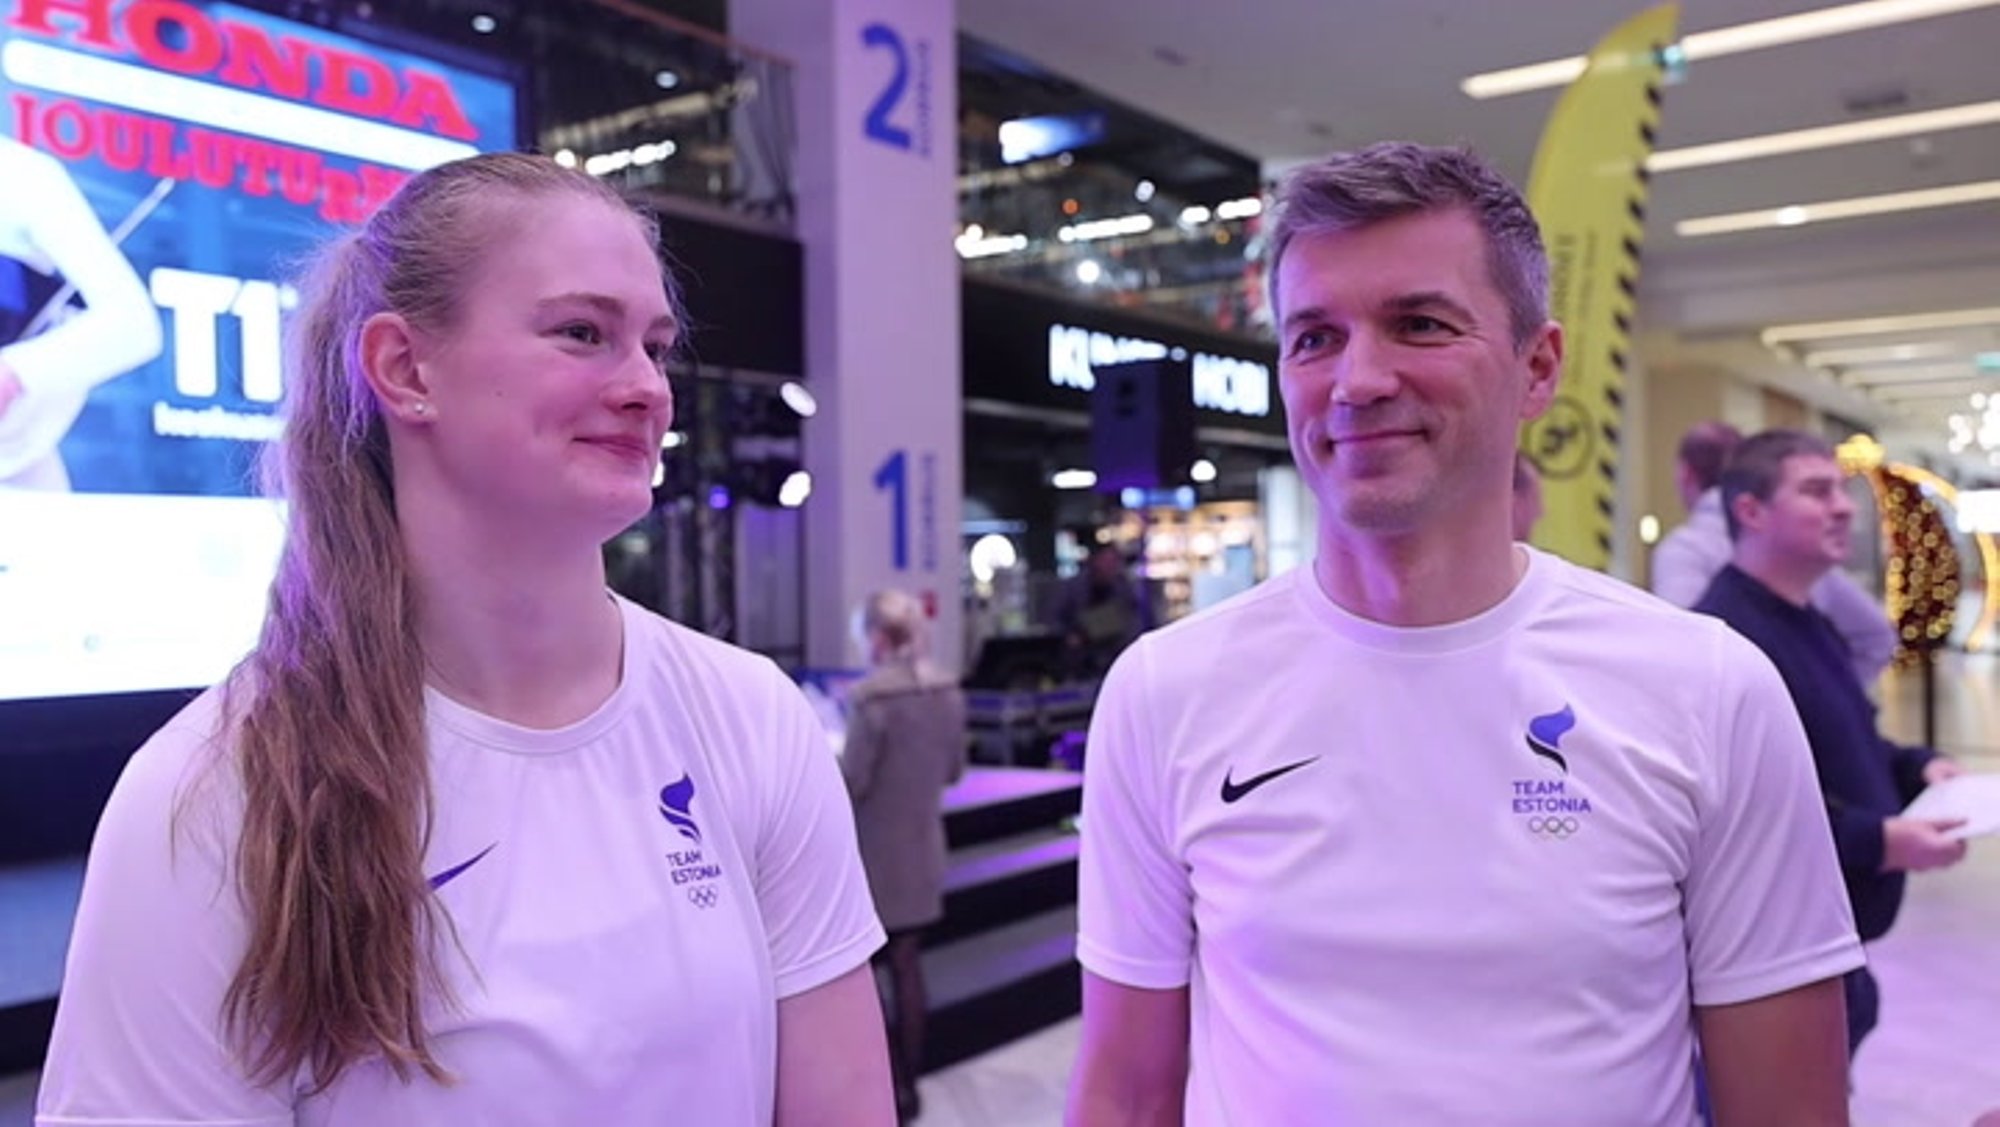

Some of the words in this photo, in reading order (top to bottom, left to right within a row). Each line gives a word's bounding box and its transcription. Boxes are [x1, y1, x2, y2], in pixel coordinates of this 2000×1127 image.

[3, 0, 477, 143] HONDA
[861, 22, 911, 152] 2
[873, 450, 908, 571] 1
[1512, 780, 1564, 794] TEAM
[1512, 798, 1591, 813] ESTONIA
[665, 850, 702, 866] TEAM
[670, 864, 721, 885] ESTONIA
